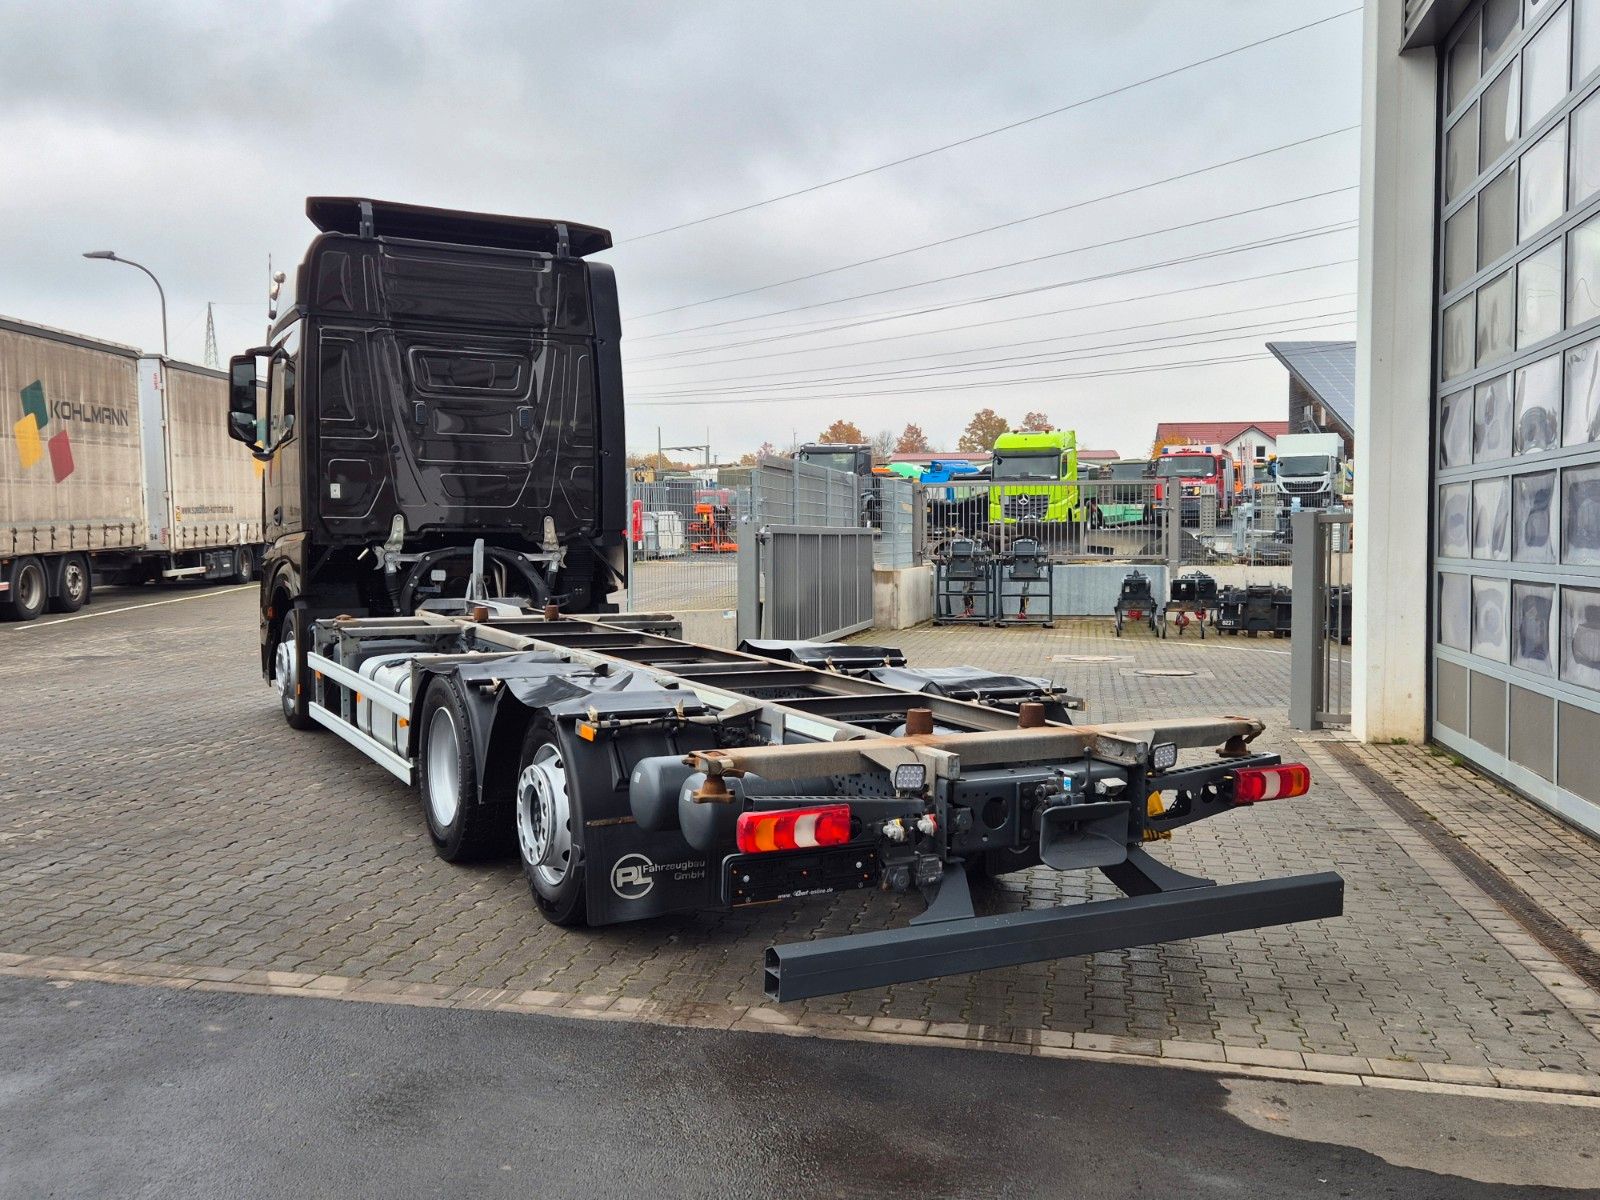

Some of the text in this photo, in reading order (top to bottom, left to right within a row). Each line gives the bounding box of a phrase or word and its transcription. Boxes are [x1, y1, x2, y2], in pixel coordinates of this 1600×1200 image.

[49, 400, 129, 427] KOHLMANN
[642, 860, 705, 873] Fahrzeugbau
[674, 871, 705, 881] GmbH
